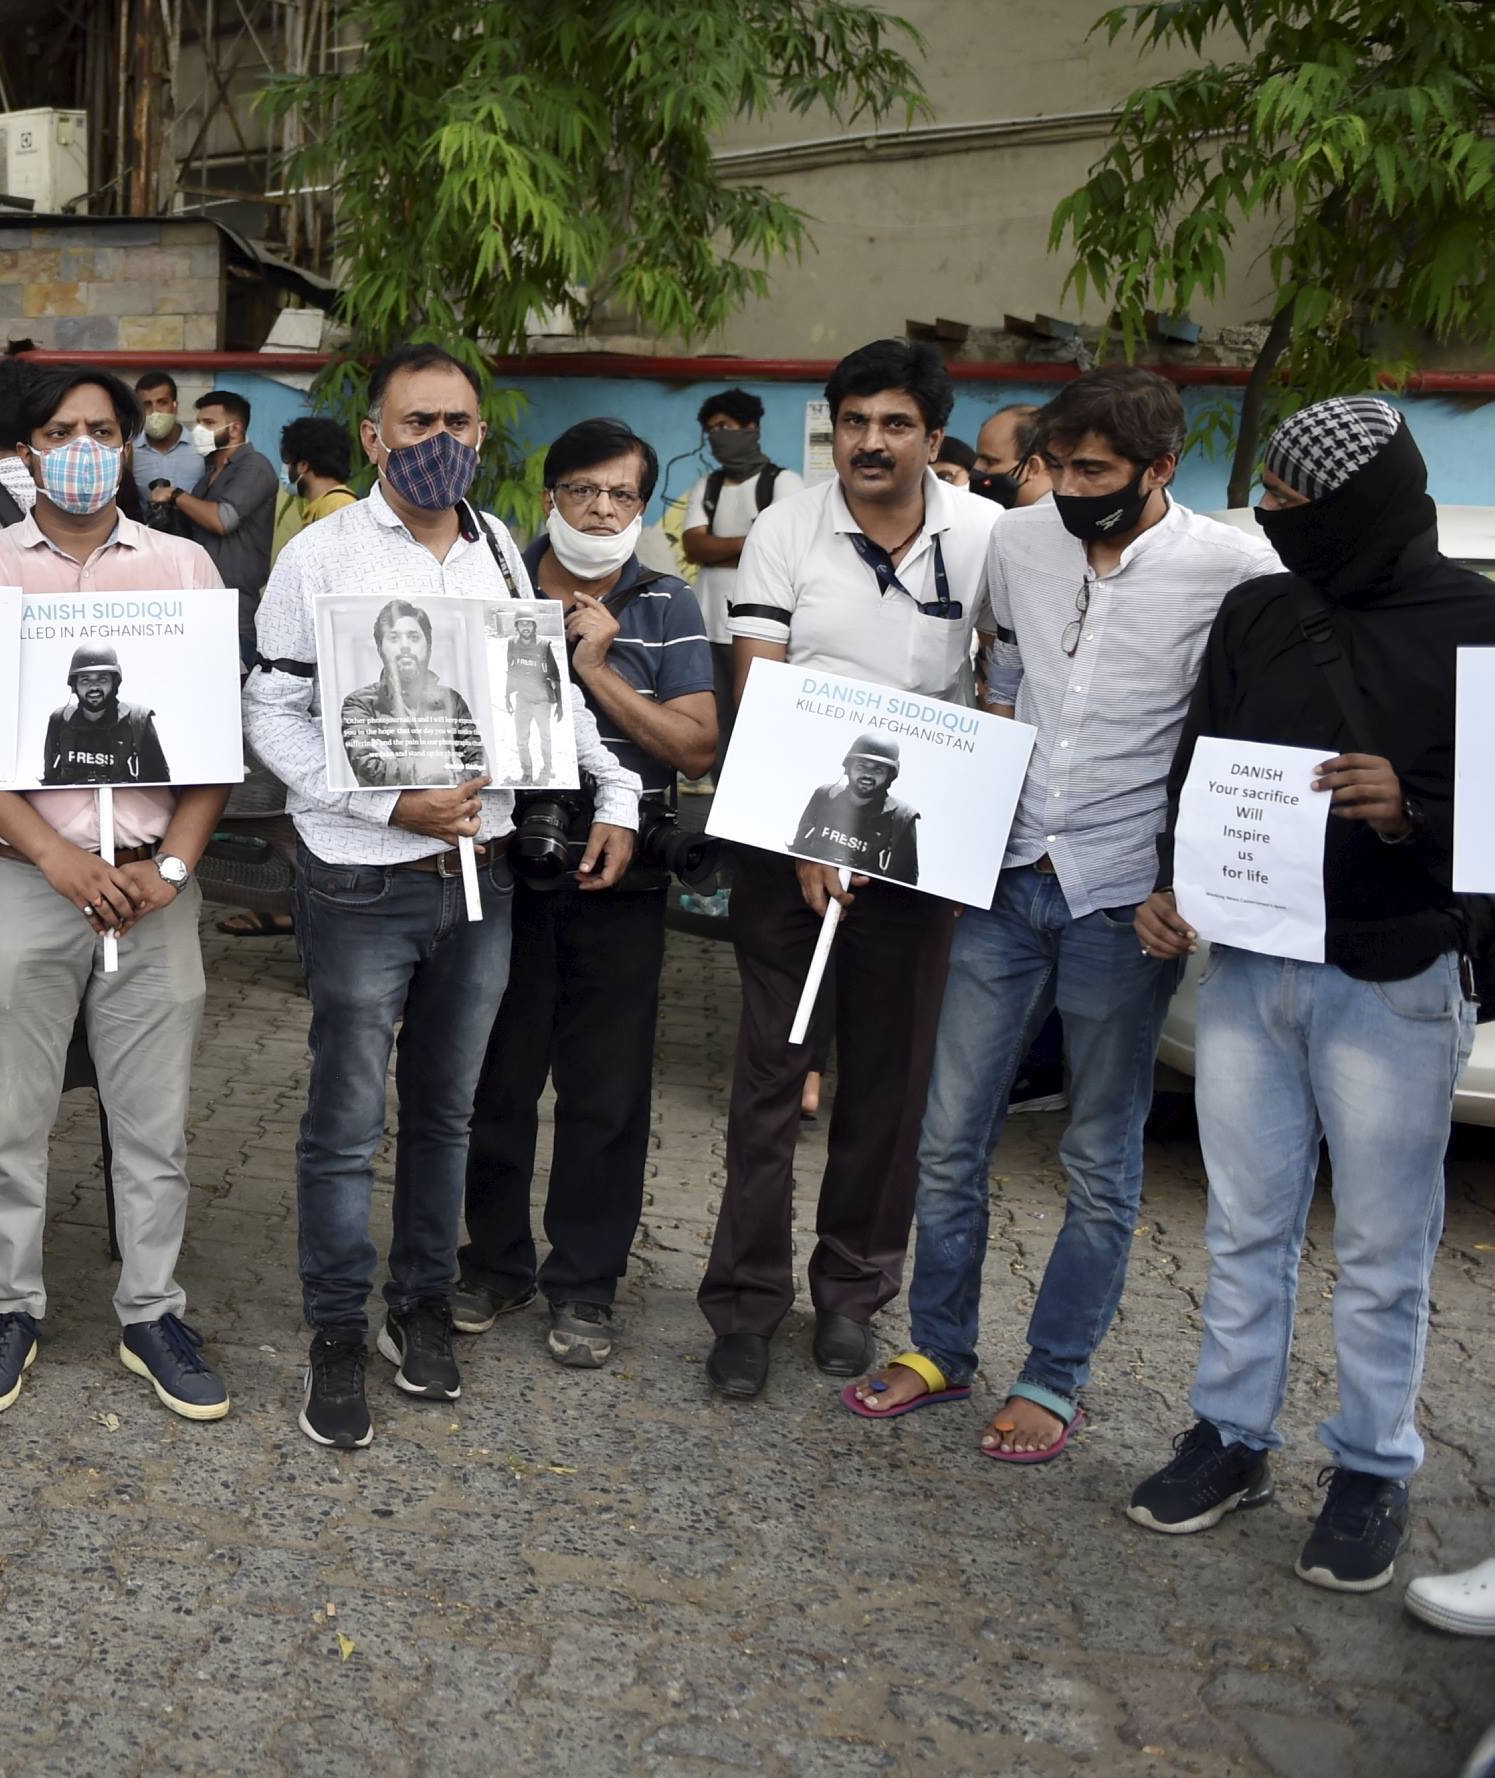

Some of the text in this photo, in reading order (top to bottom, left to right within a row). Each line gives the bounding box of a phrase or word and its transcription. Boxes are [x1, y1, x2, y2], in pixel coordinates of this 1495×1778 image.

[22, 601, 183, 621] ANISH SIDDIQUI
[20, 623, 185, 640] LLED IN AFGHANISTAN
[801, 678, 980, 736] DANISH SIDDIQUI
[796, 698, 976, 753] KILLED IN AFGHANISTAN
[1230, 764, 1283, 782] DANISH
[1208, 780, 1300, 806] Your sacrifice
[1236, 806, 1263, 821] Will
[1224, 824, 1270, 844] Inspire
[1238, 850, 1254, 862] us
[1222, 865, 1269, 884] for life
